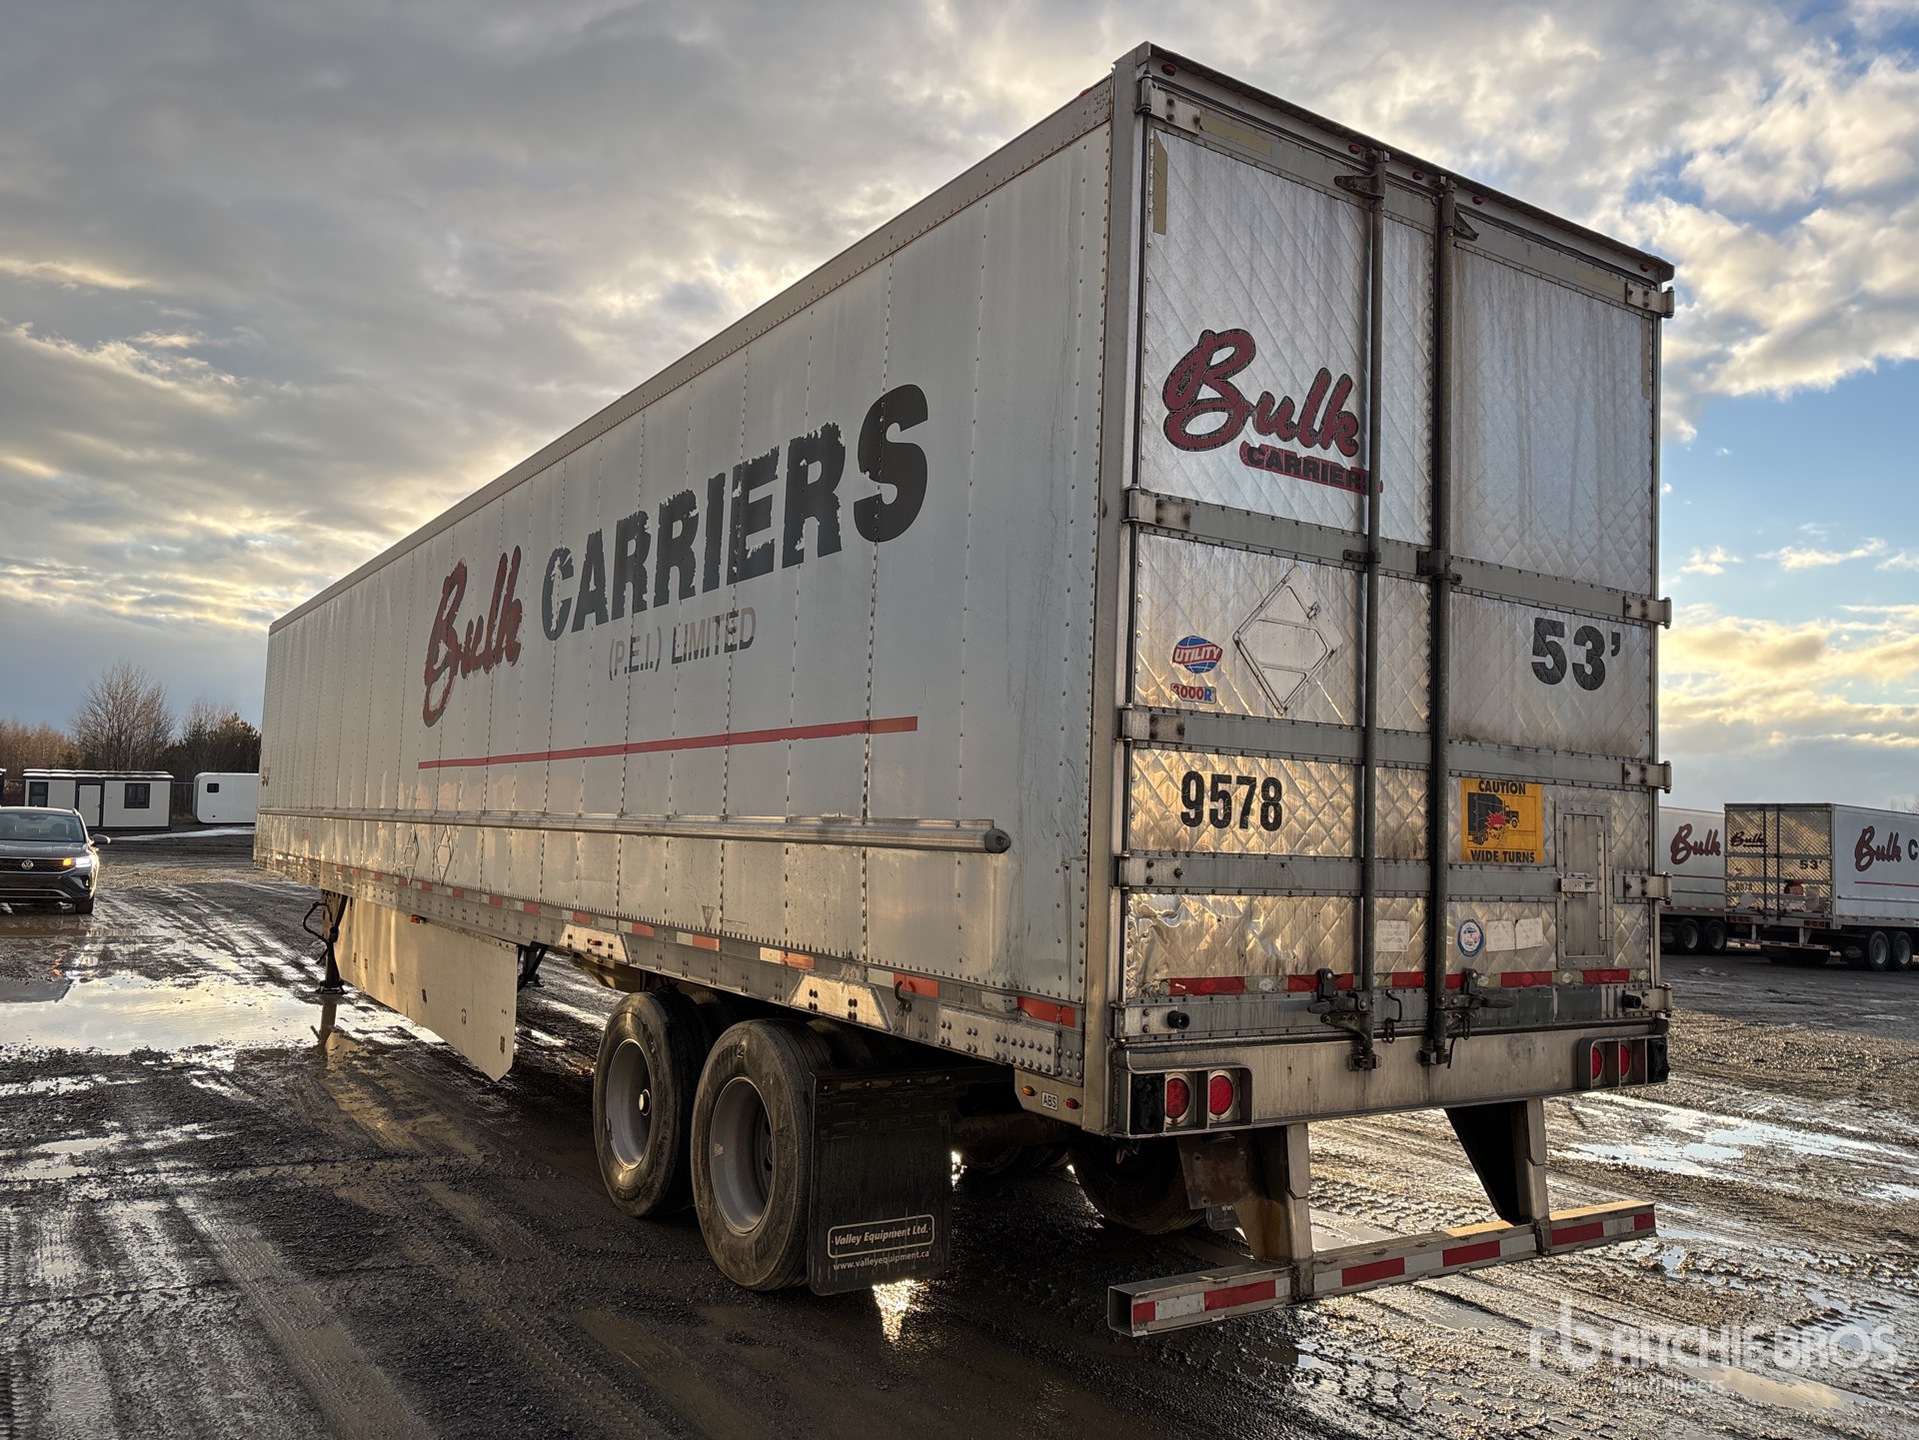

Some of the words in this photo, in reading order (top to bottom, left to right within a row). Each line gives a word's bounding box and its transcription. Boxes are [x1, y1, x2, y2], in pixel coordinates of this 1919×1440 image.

[1163, 329, 1360, 457] Bulk
[423, 545, 523, 727] Bulk
[541, 384, 929, 641] CARRIERS
[671, 607, 756, 664] LIMITED
[1174, 646, 1221, 663] UTILITY
[1173, 683, 1212, 702] 3000R
[1478, 780, 1527, 795] CAUTION
[1180, 770, 1283, 832] 9578
[1670, 823, 1721, 865] Bulk
[1854, 826, 1902, 872] Bulk
[1470, 850, 1499, 862] WIDE
[1502, 851, 1535, 863] TURNS
[1043, 1094, 1057, 1109] ABS
[834, 1234, 862, 1246] Valley
[863, 1226, 911, 1244] Equipment
[833, 1250, 930, 1271] www.valleyequipment.ca
